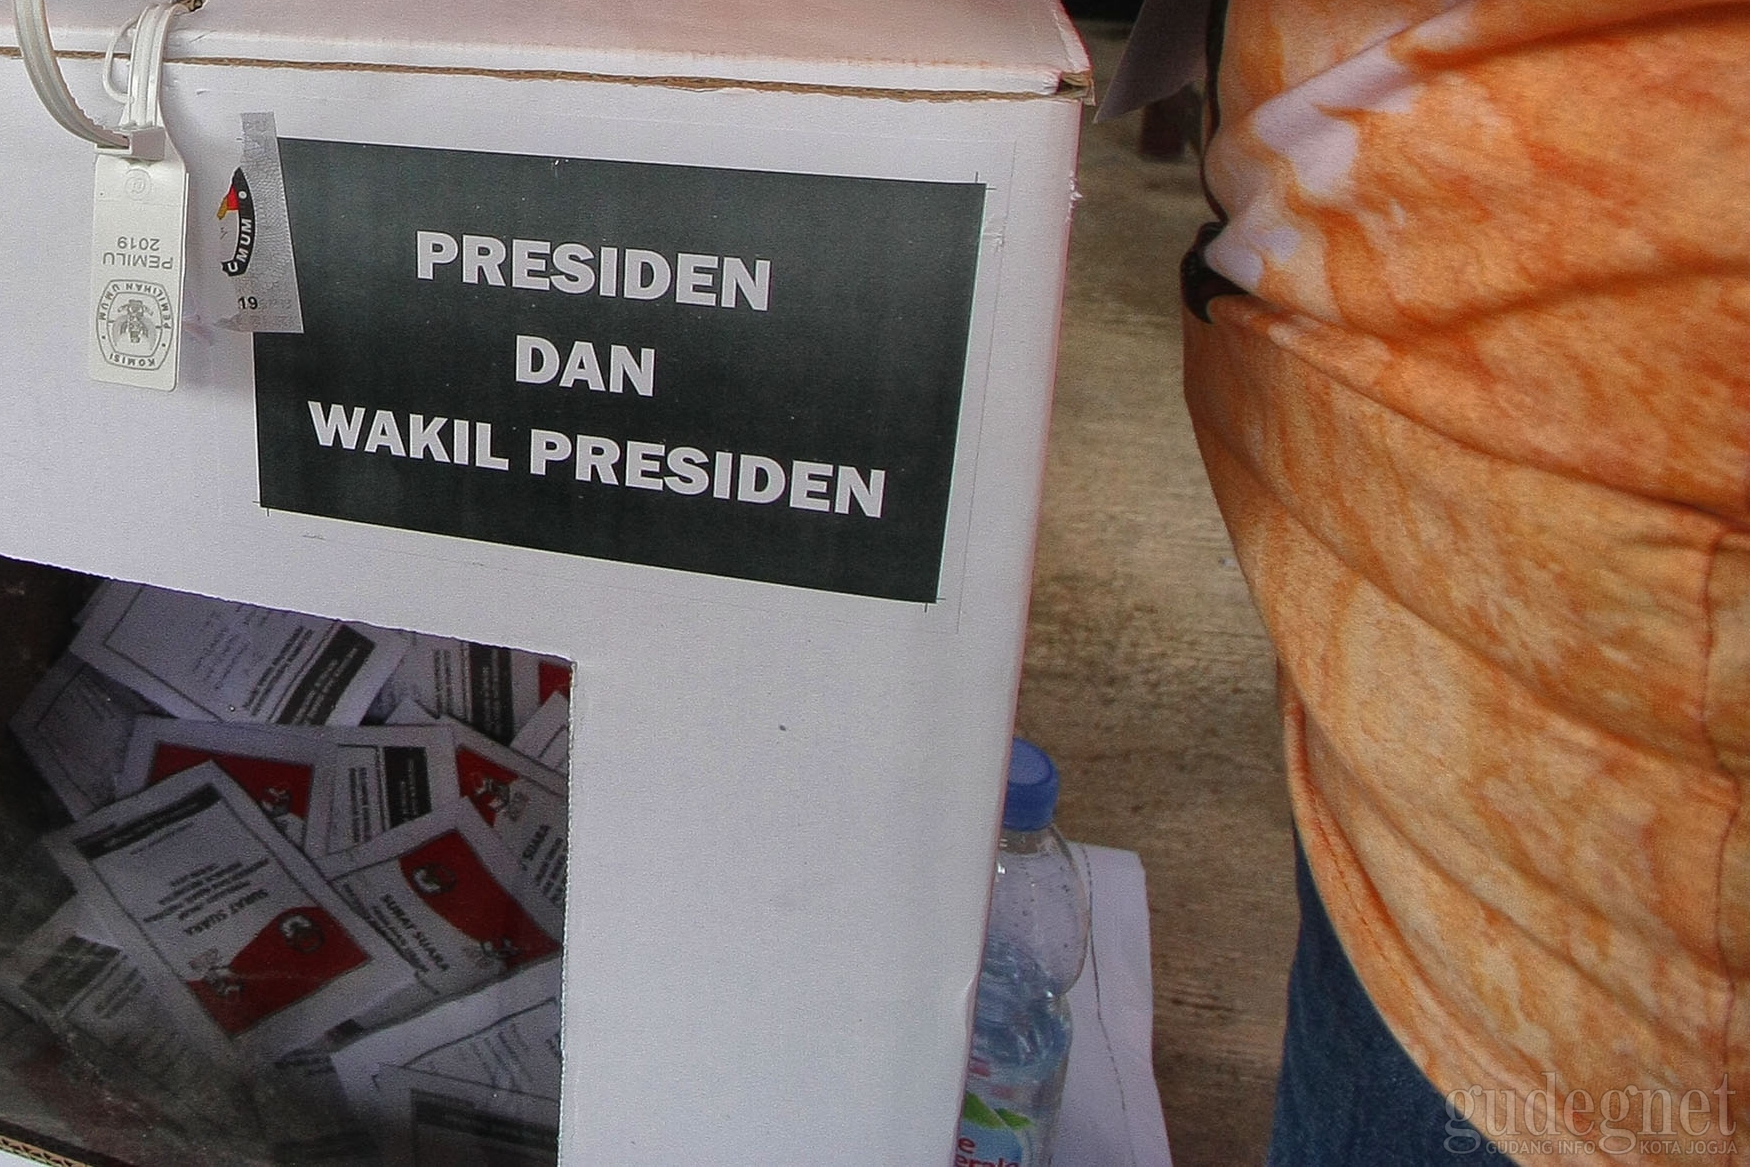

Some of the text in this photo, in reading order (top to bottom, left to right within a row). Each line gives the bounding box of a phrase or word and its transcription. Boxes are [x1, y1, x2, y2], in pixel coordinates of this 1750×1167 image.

[103, 252, 173, 269] PEMILU
[117, 236, 160, 251] 2019
[227, 218, 253, 273] UMUM
[416, 230, 772, 312] PRESIDEN
[99, 283, 172, 329] PEMILIHAN UMUM
[109, 353, 155, 367] KOMISI
[515, 334, 656, 397] DAN
[307, 401, 885, 519] WAKIL PRESIDEN
